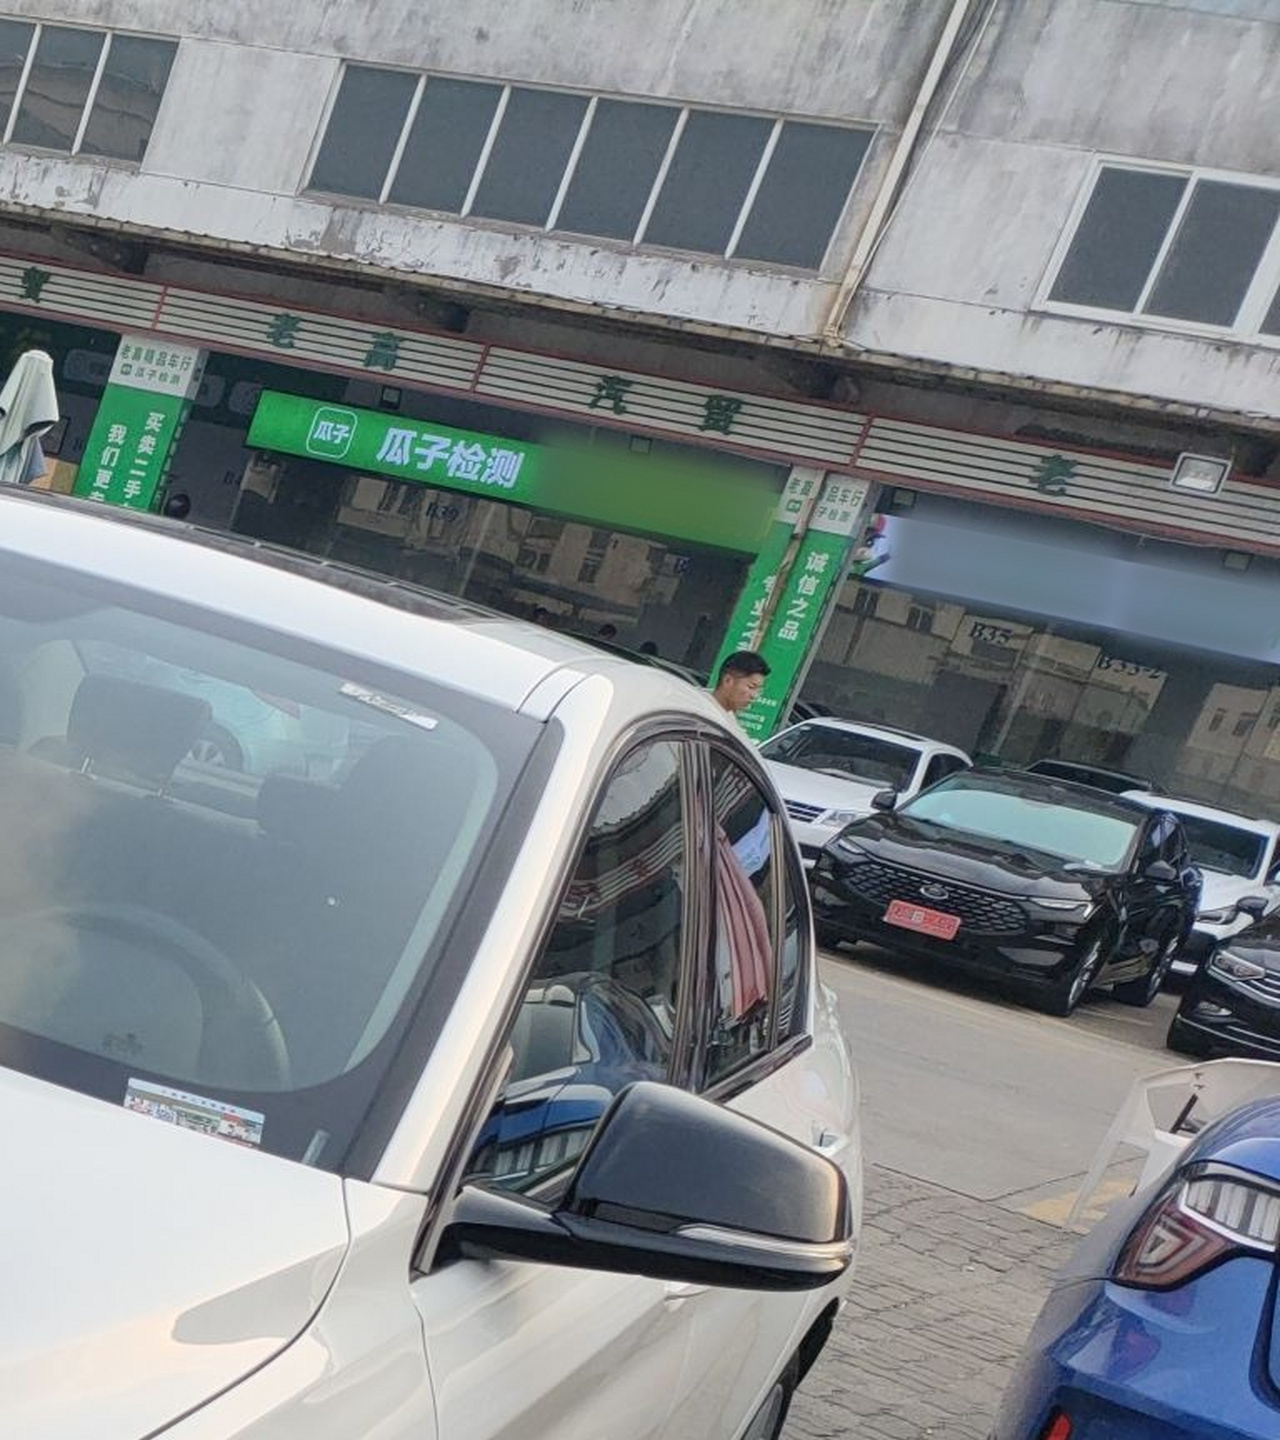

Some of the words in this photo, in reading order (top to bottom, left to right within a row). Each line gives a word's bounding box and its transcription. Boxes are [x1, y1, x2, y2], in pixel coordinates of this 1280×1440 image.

[122, 412, 166, 507] 买卖二手
[313, 420, 351, 445] 瓜子
[377, 426, 525, 489] 瓜子检测
[777, 550, 830, 641] 诚信之品
